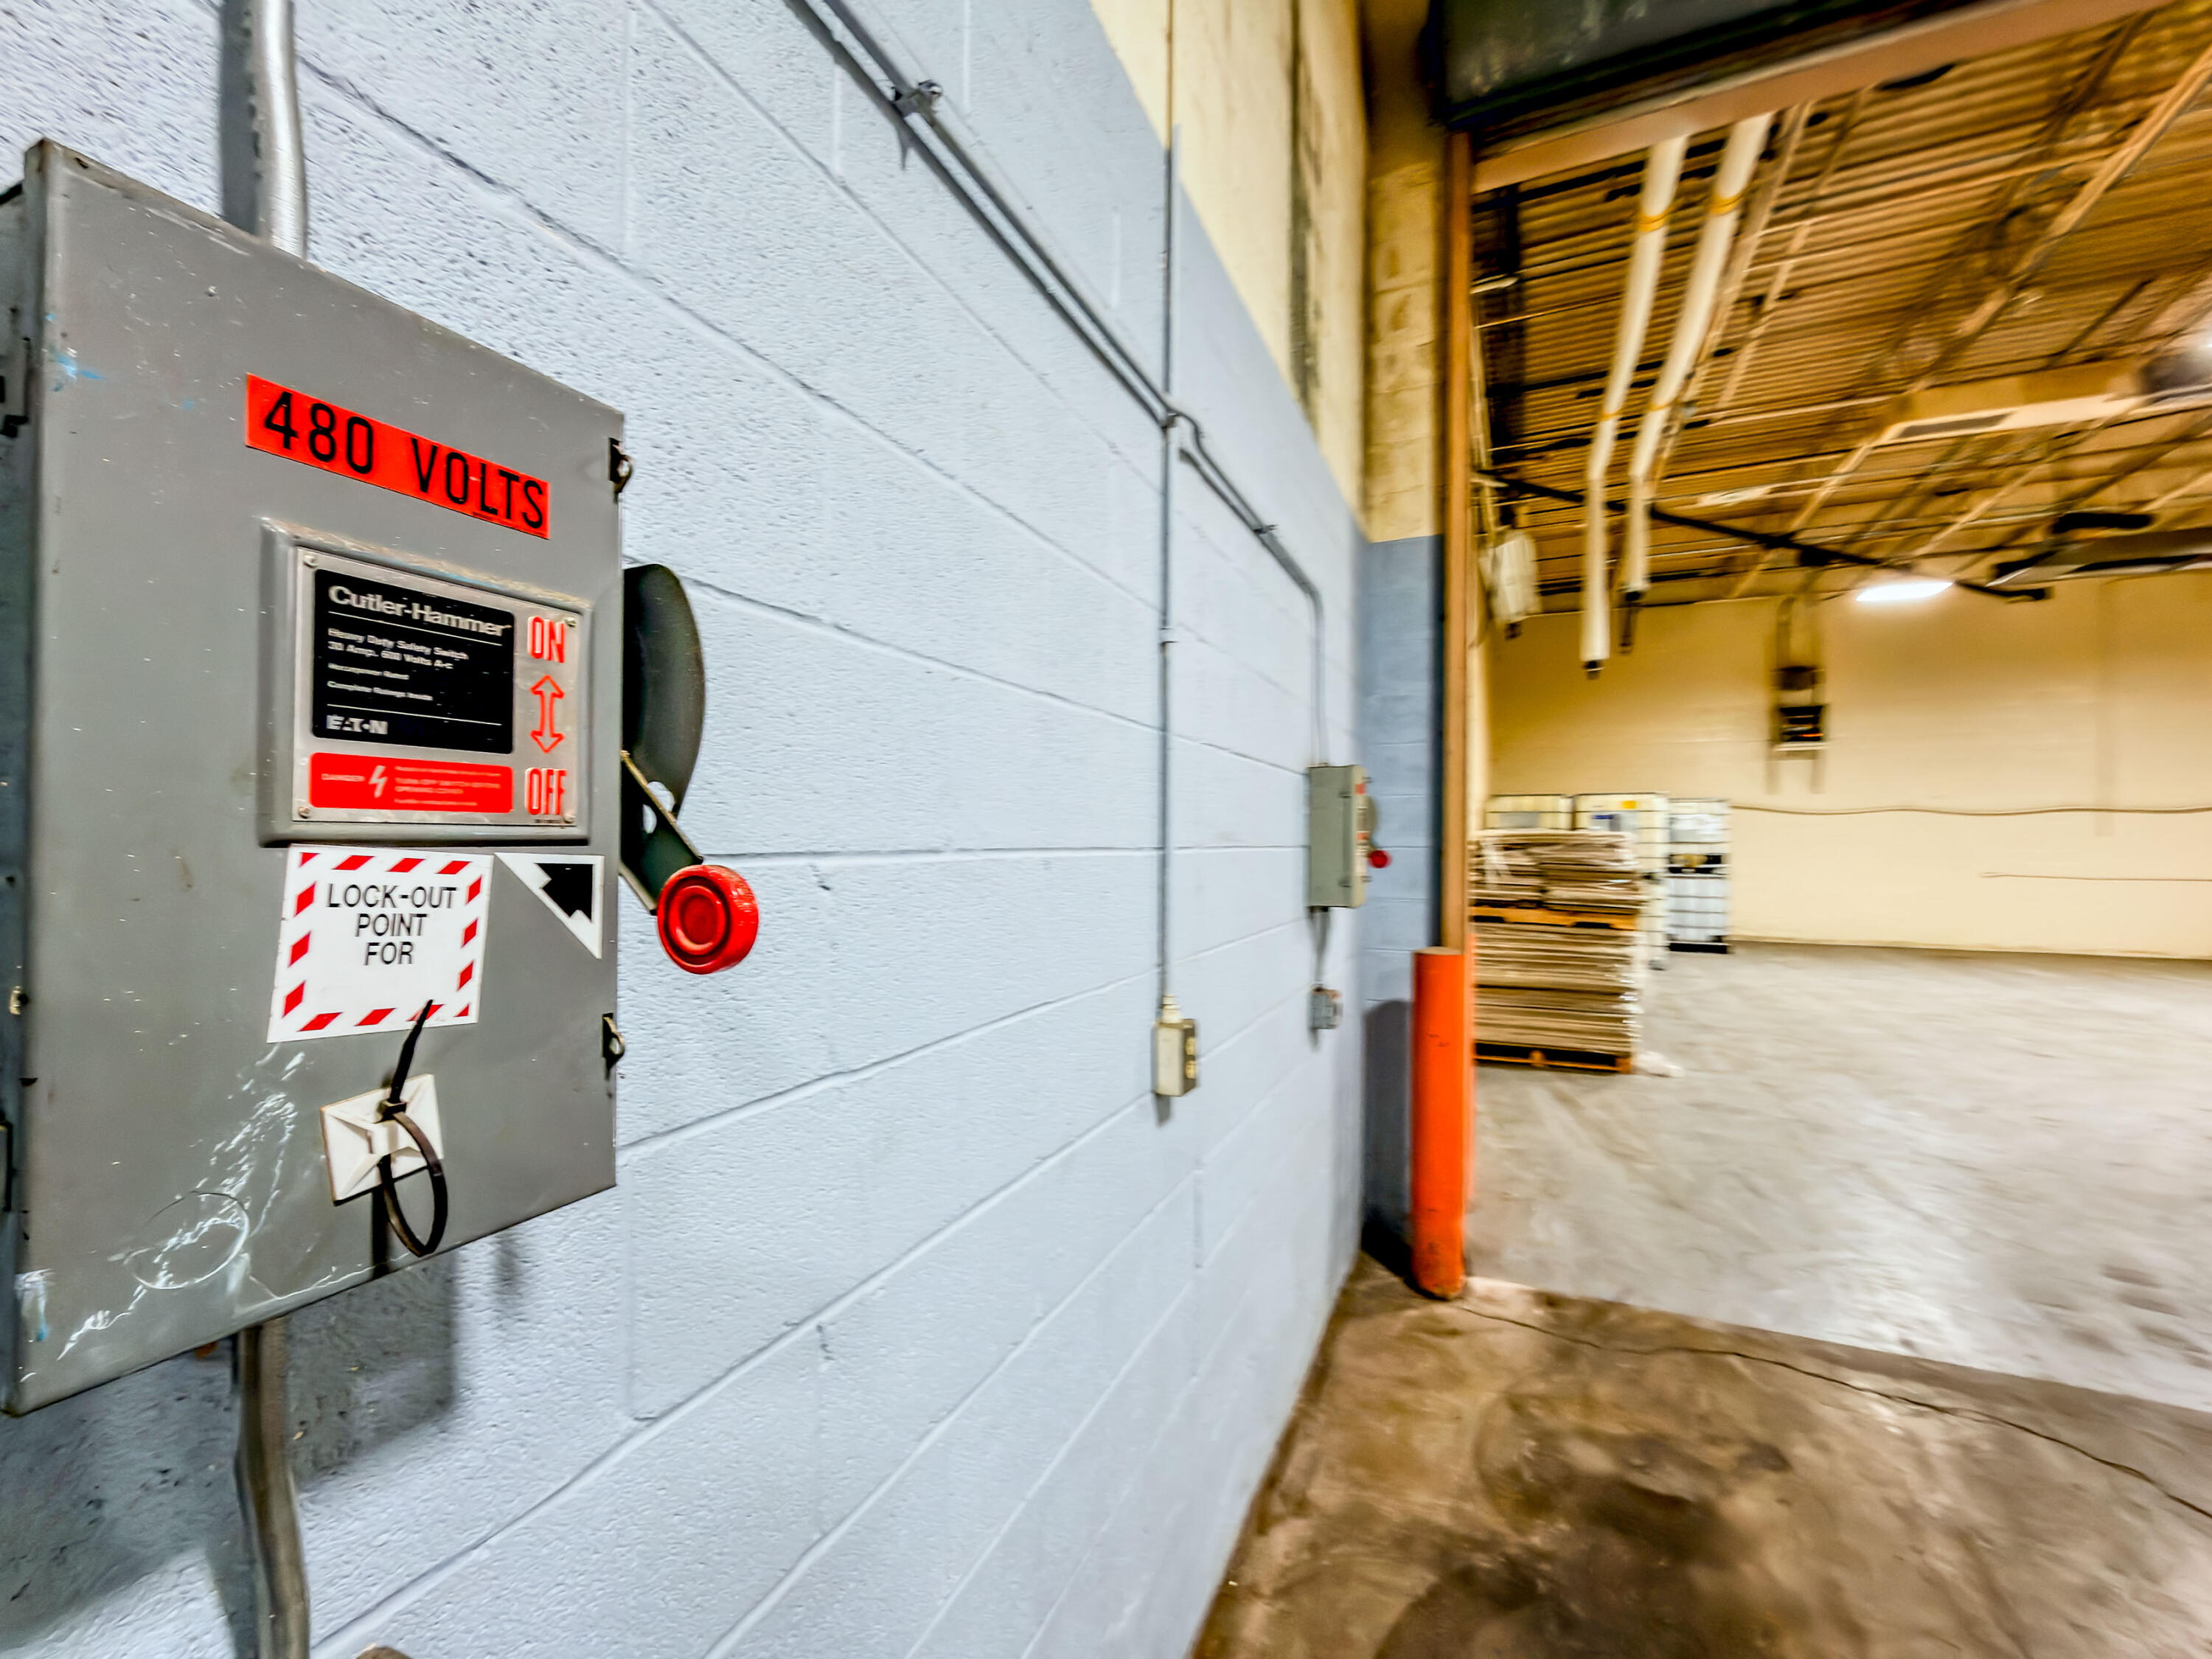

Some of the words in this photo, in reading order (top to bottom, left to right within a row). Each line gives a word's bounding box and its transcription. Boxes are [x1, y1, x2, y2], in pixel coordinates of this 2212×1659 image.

[264, 392, 373, 474] 480
[411, 437, 543, 529] VOLTS
[328, 585, 504, 637] Cutler-Hammer
[527, 616, 566, 664] ON
[524, 768, 567, 815] OFF
[326, 883, 459, 909] LOCK-OUT
[355, 913, 428, 937] POINT
[364, 941, 414, 965] FOR
